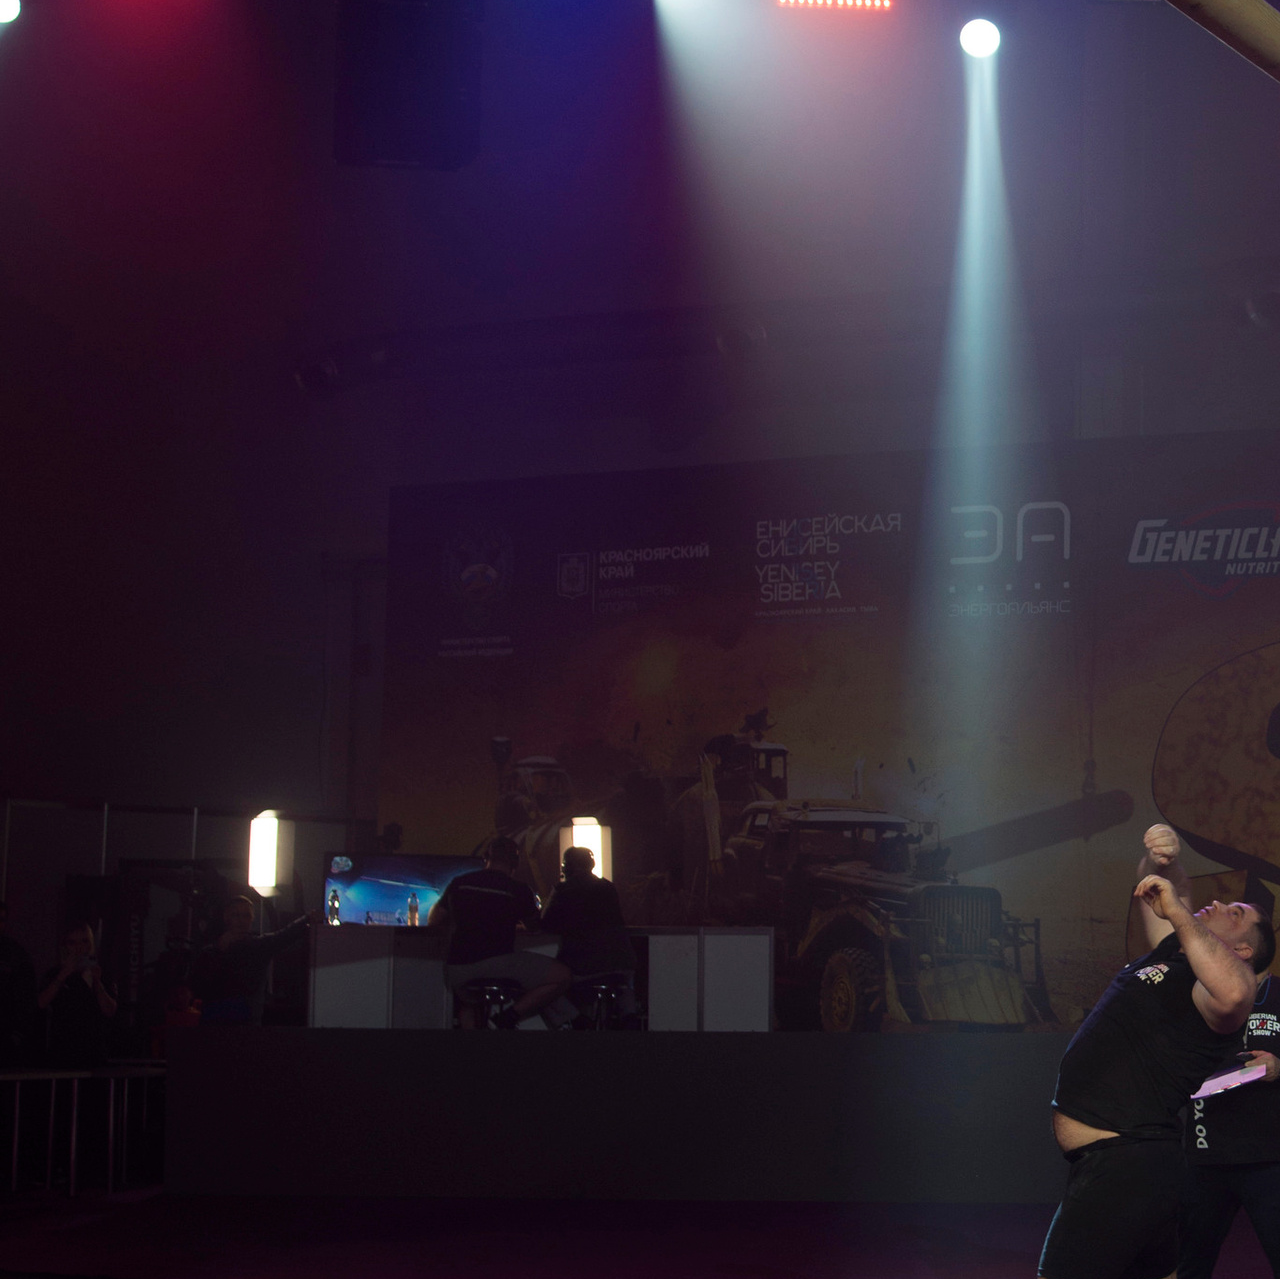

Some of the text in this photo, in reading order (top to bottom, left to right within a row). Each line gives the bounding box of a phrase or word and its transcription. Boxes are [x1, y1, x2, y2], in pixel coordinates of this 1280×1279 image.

[755, 513, 902, 539] ЕНИСЕЙСКАЯ
[598, 541, 710, 564] КРАСНОЯРСКИЙ
[755, 536, 841, 558] СИБИРЬ
[598, 562, 635, 580] КРАЙ
[755, 560, 841, 583] YENISEY
[760, 580, 842, 603] SIBERIA
[949, 600, 1071, 617] ЭНЕРГОАЛЬЯНС
[1195, 1124, 1209, 1149] DO
